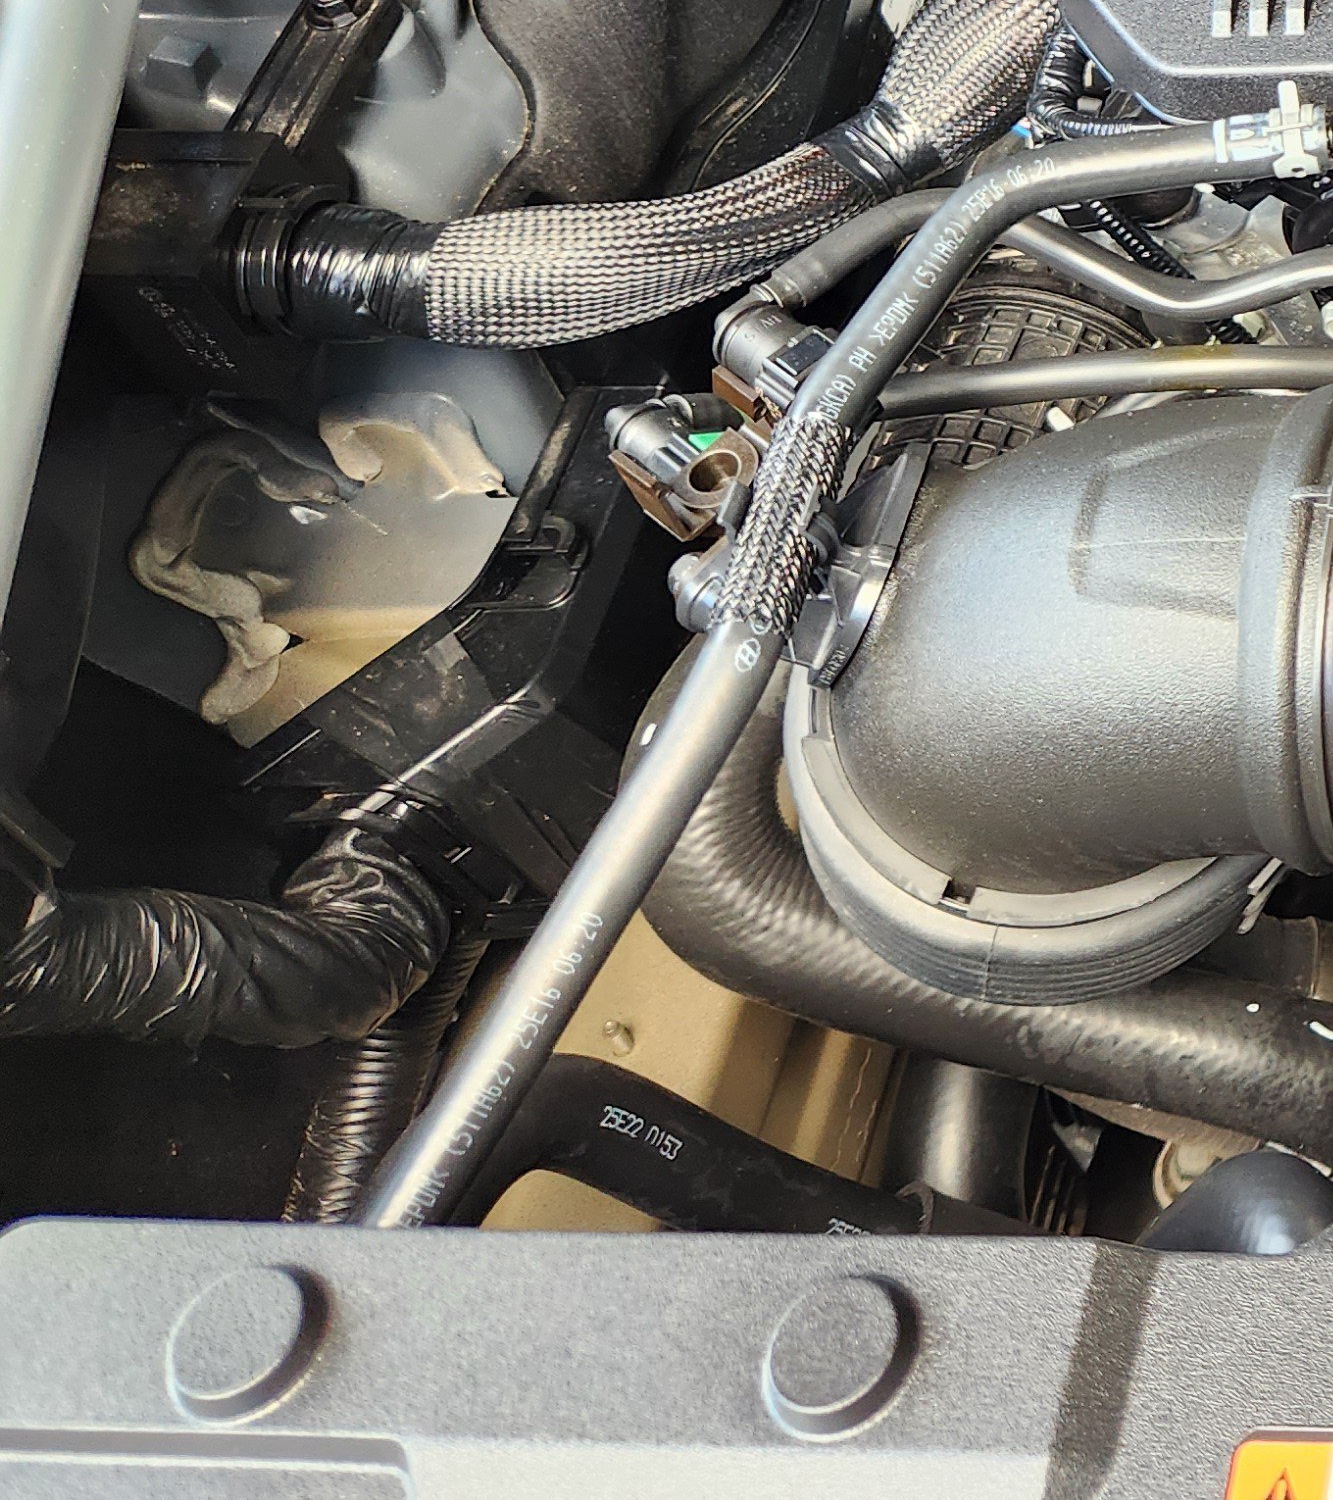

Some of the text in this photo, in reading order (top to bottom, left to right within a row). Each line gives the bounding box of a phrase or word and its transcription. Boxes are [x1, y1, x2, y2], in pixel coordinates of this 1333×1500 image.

[848, 346, 878, 375] PH
[912, 220, 969, 290] (511A62)
[598, 1104, 645, 1139] 25E22
